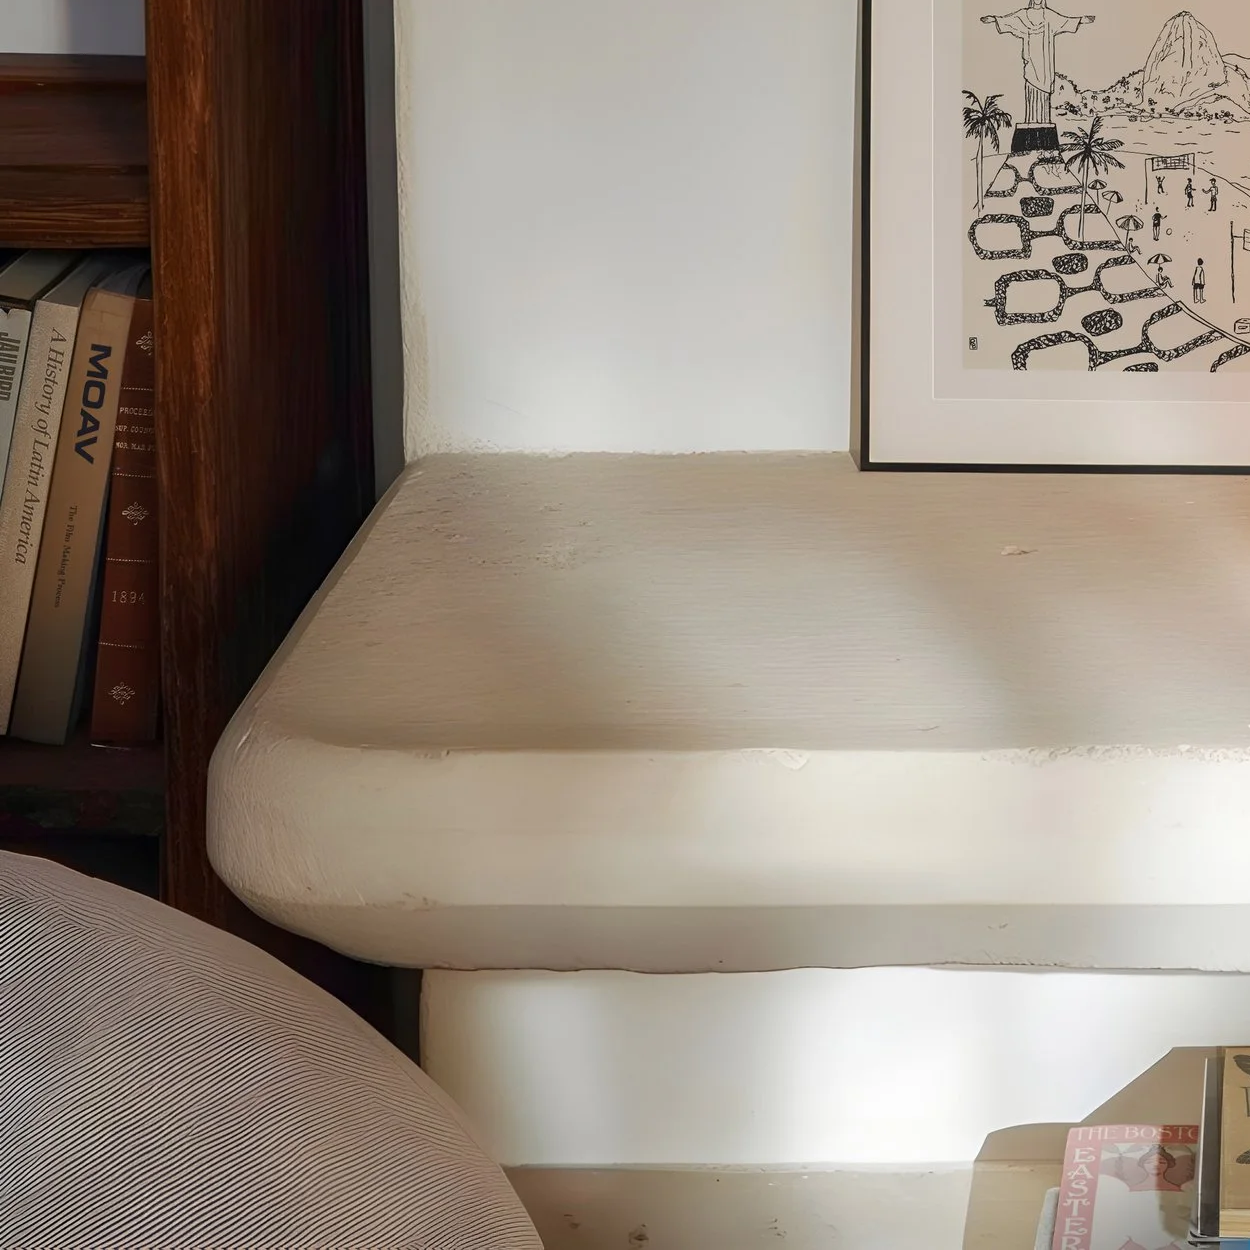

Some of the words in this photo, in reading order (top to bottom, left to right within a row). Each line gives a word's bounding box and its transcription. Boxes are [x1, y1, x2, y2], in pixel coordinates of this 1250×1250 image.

[50, 326, 67, 343] A
[35, 347, 65, 415] History
[74, 343, 112, 464] MOAV
[31, 418, 52, 439] of
[28, 438, 50, 487] Latin
[15, 488, 40, 565] America
[68, 505, 78, 522] The
[64, 524, 75, 542] Film
[57, 545, 71, 576] Making
[54, 578, 66, 608] Process
[1075, 1126, 1118, 1140] THE
